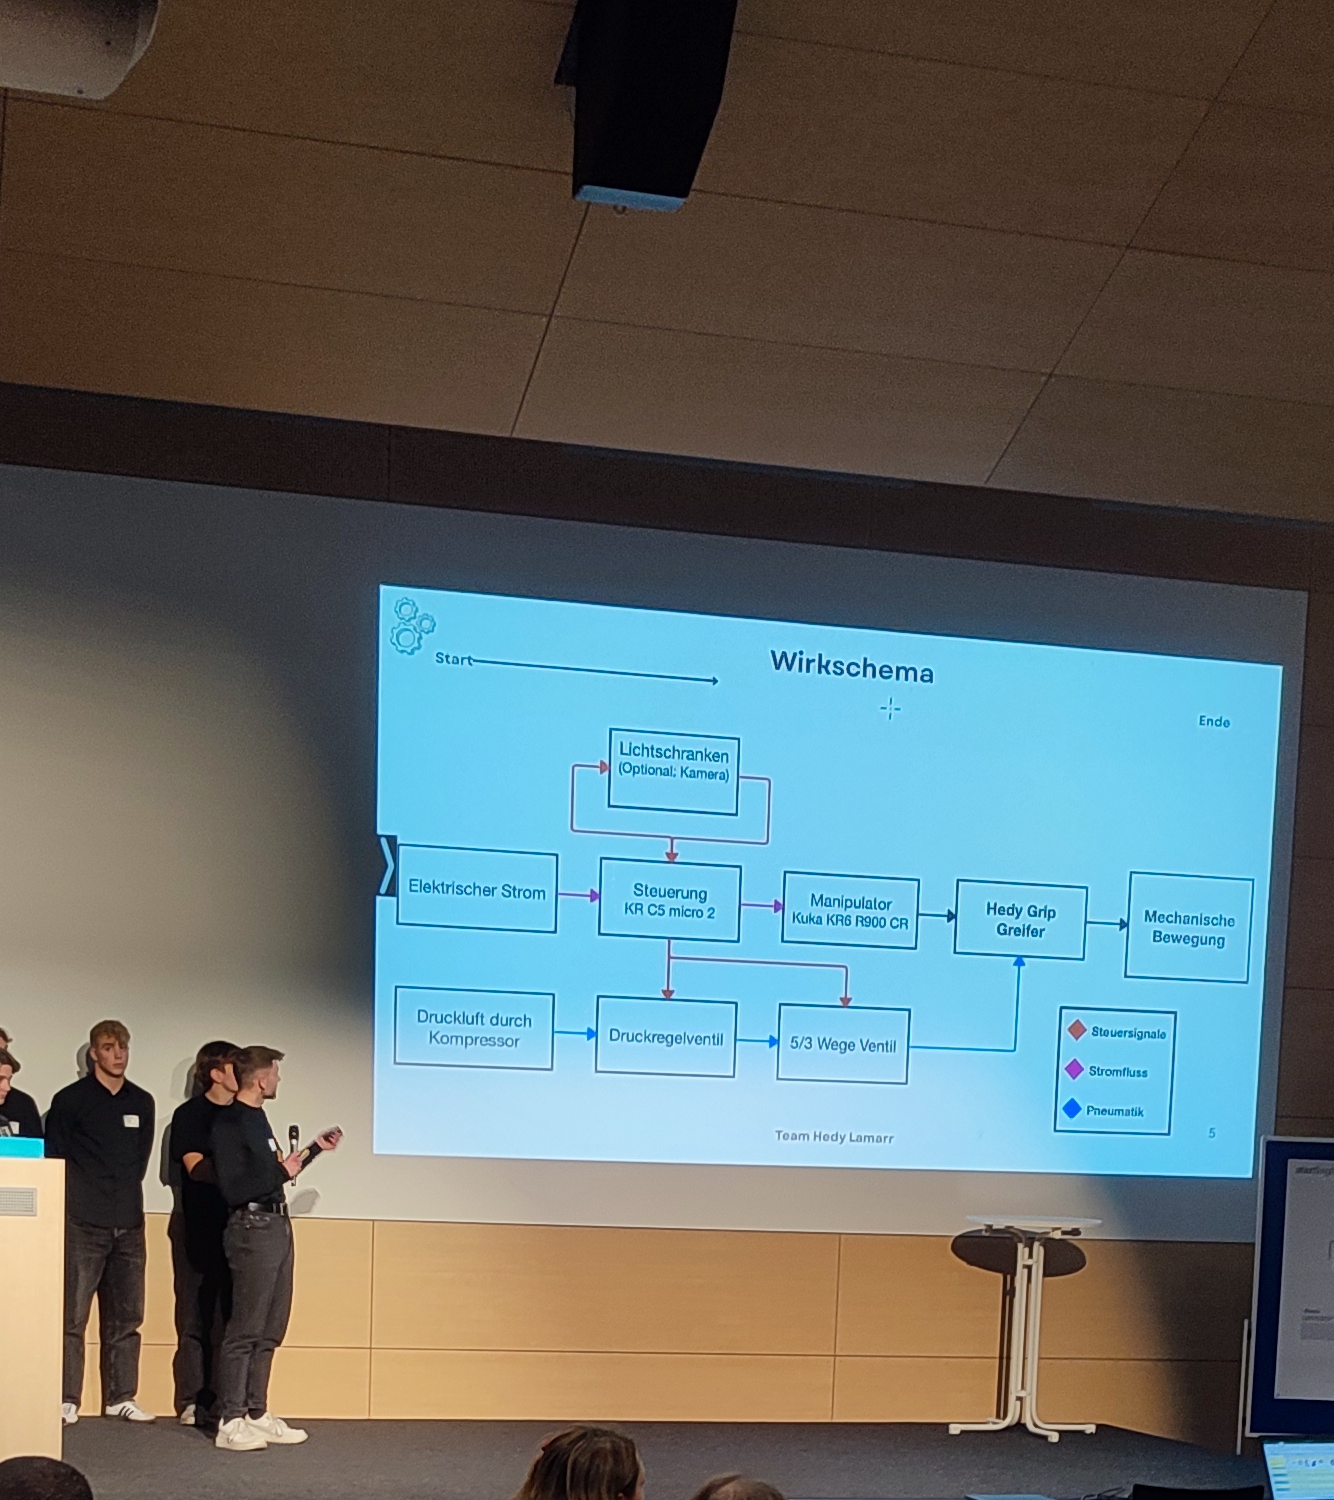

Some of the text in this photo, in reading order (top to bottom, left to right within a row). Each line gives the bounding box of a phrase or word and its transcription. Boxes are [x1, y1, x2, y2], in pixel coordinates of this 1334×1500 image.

[435, 652, 474, 667] Start
[770, 649, 934, 684] Wirkschema
[1198, 714, 1231, 729] Ende
[619, 741, 730, 764] Lichtschranken
[680, 765, 730, 784] Kamera)
[409, 878, 546, 900] Elektrischer Strom
[633, 882, 708, 903] Steuerung
[624, 902, 716, 919] KR C5 micro 2
[810, 893, 893, 914] Manipulator
[986, 901, 1057, 921] Hedy Grip
[792, 911, 909, 930] Kuka KR6 R900 CR
[1144, 909, 1235, 928] Mechanische
[996, 923, 1046, 939] Greifer
[1152, 930, 1226, 949] Bewegung
[417, 1009, 532, 1028] Druckluft durch
[429, 1030, 520, 1049] Kompressor
[609, 1028, 724, 1047] Druckregelventil
[1091, 1026, 1167, 1041] Steuersignale
[790, 1036, 897, 1054] 5/3 Wege Ventil
[1088, 1066, 1148, 1078] Stromfluss
[1086, 1105, 1145, 1118] Pneumatik
[775, 1130, 894, 1145] Team Hedy Lamarr
[1208, 1127, 1216, 1138] 5
